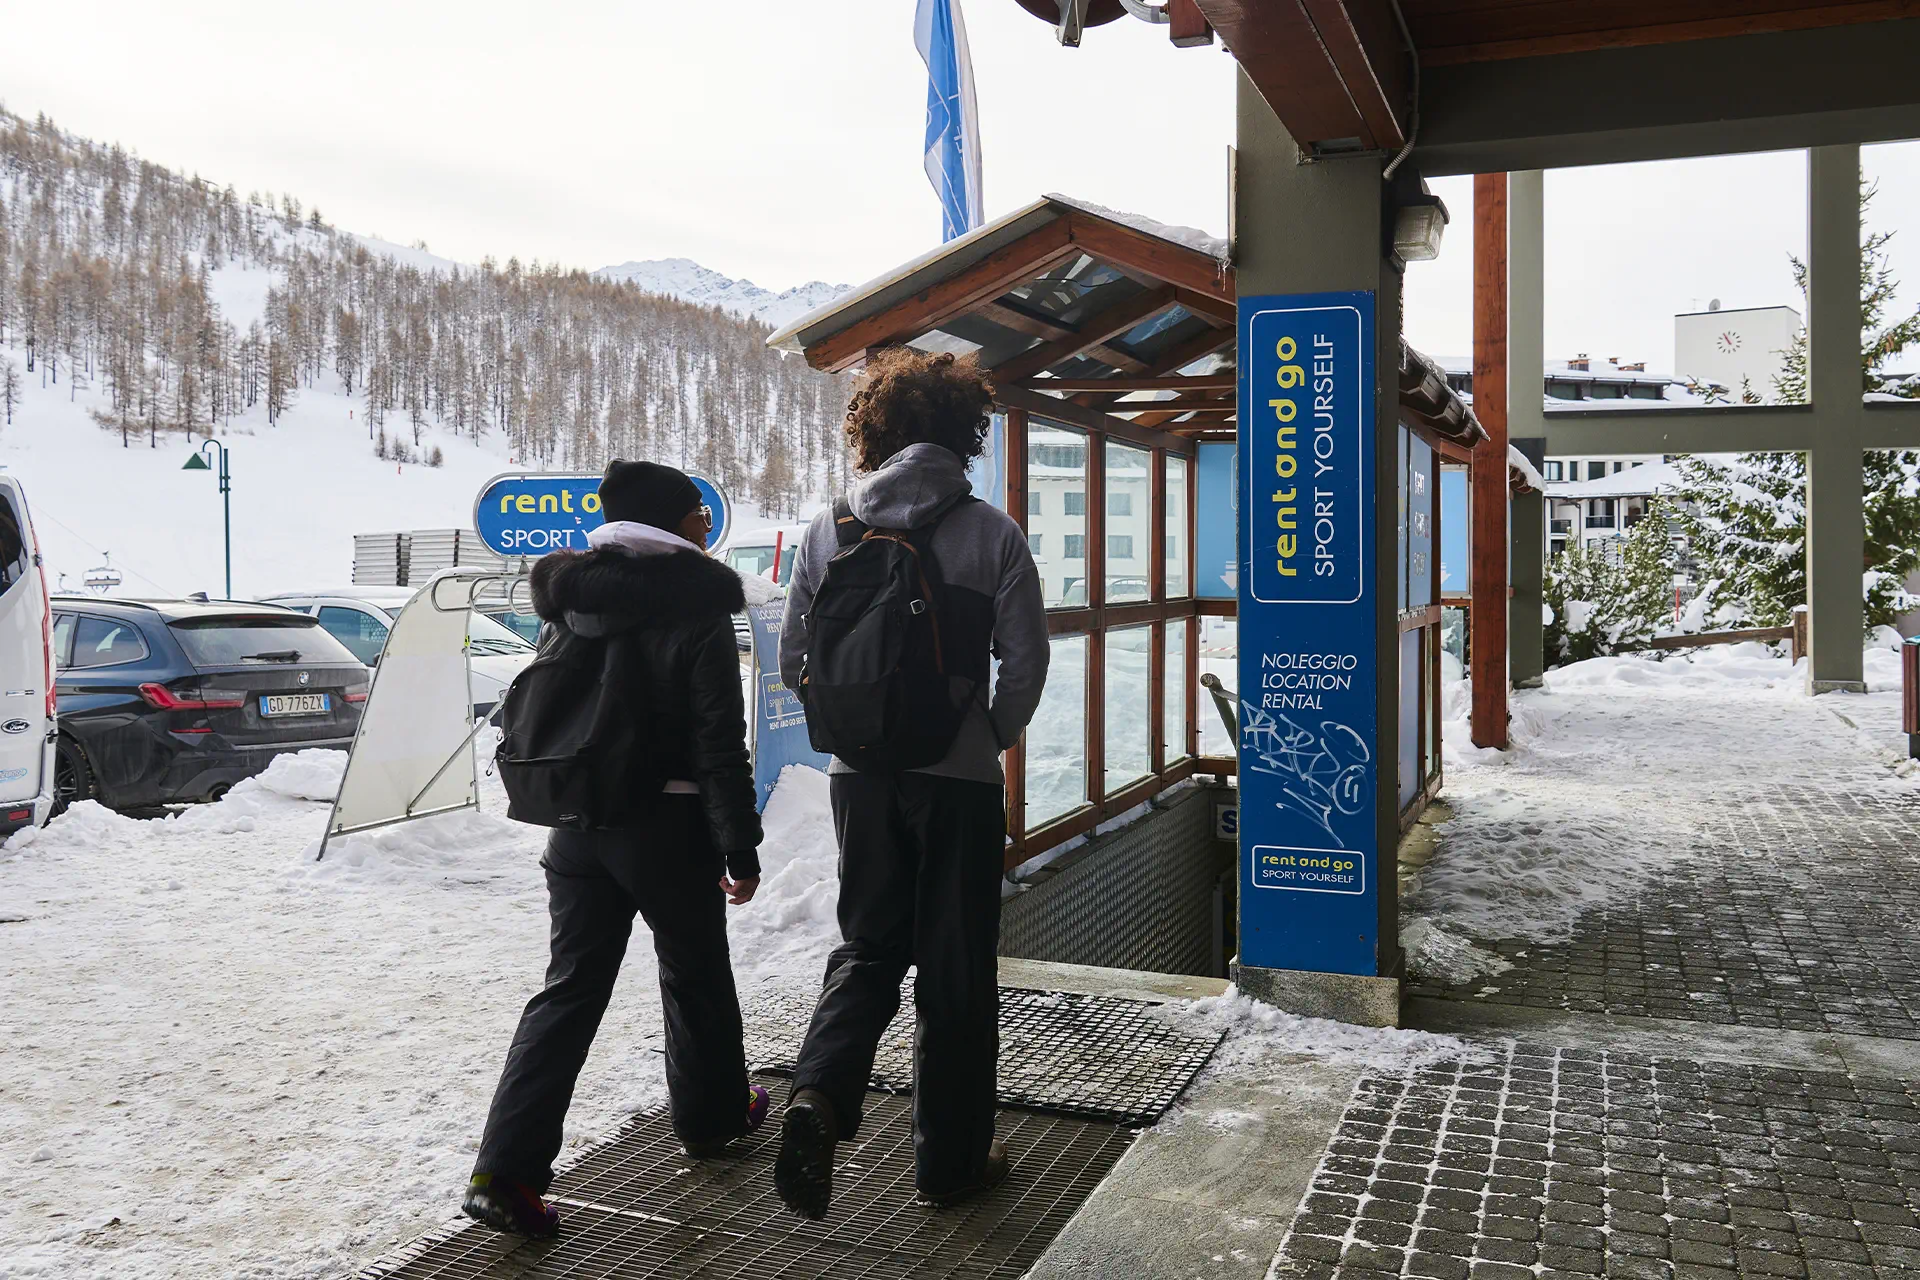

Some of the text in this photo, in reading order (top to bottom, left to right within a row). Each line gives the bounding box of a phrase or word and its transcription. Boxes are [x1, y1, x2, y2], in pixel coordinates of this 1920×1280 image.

[1268, 336, 1305, 576] rent and go
[1313, 333, 1335, 577] SPORT YOURSELF
[500, 489, 574, 513] rent
[500, 529, 575, 548] SPORT
[756, 609, 784, 620] LOCATIO
[1262, 653, 1357, 670] NOLEGGIO
[1262, 673, 1351, 690] LOCATION
[269, 697, 283, 712] GD
[287, 695, 323, 711] 776ZX
[1262, 693, 1323, 710] RENTAL
[1262, 855, 1354, 872] rent and go
[1262, 869, 1355, 883] SPORT YOURSELF
